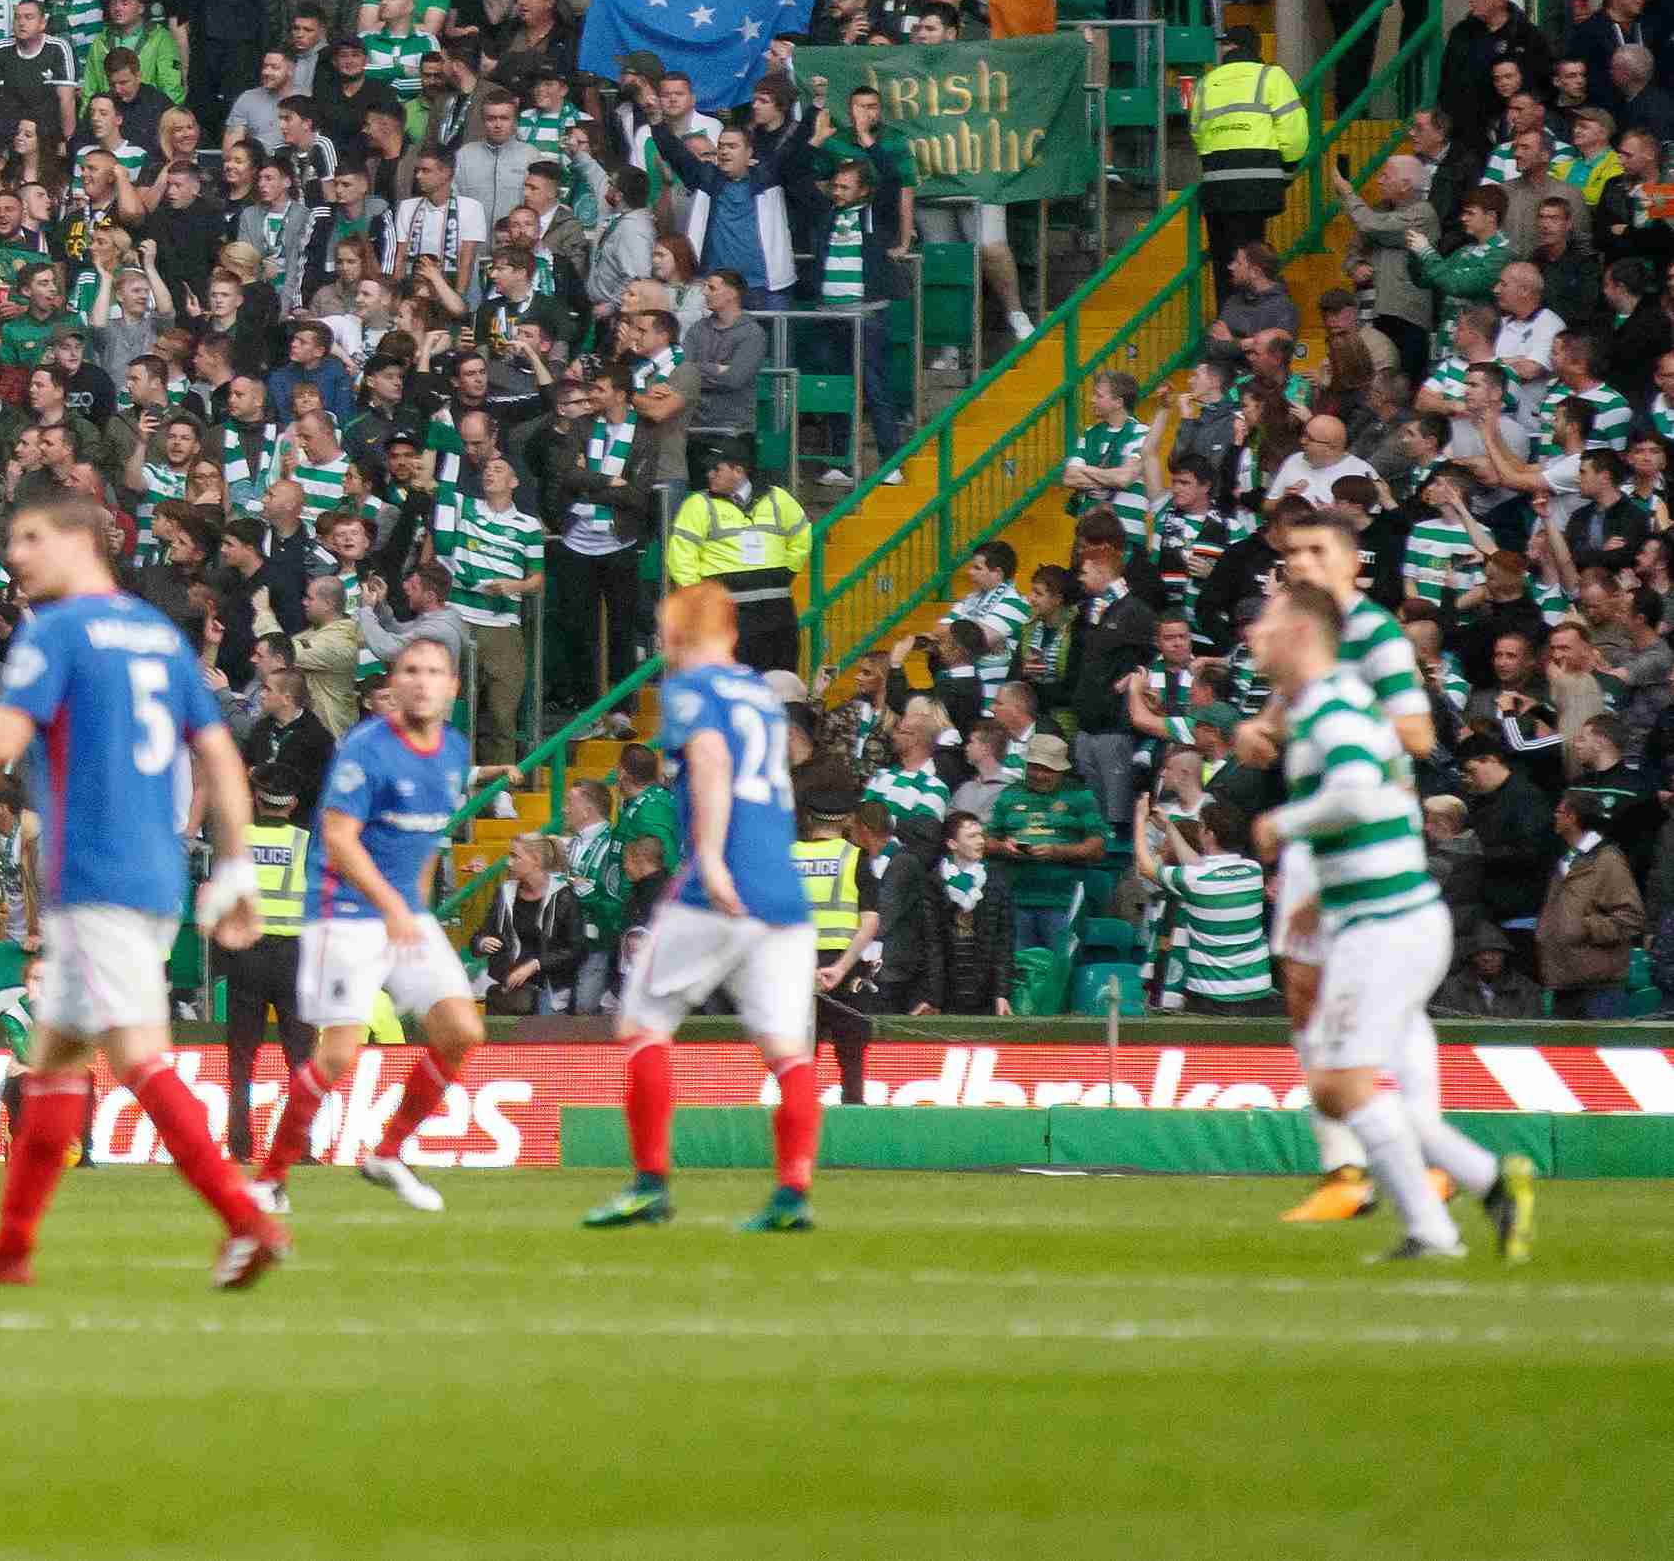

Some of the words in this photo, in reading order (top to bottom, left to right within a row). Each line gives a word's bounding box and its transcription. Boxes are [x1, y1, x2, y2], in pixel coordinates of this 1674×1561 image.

[127, 657, 176, 775] 5
[253, 846, 293, 865] OLICE
[797, 859, 839, 875] OLICE
